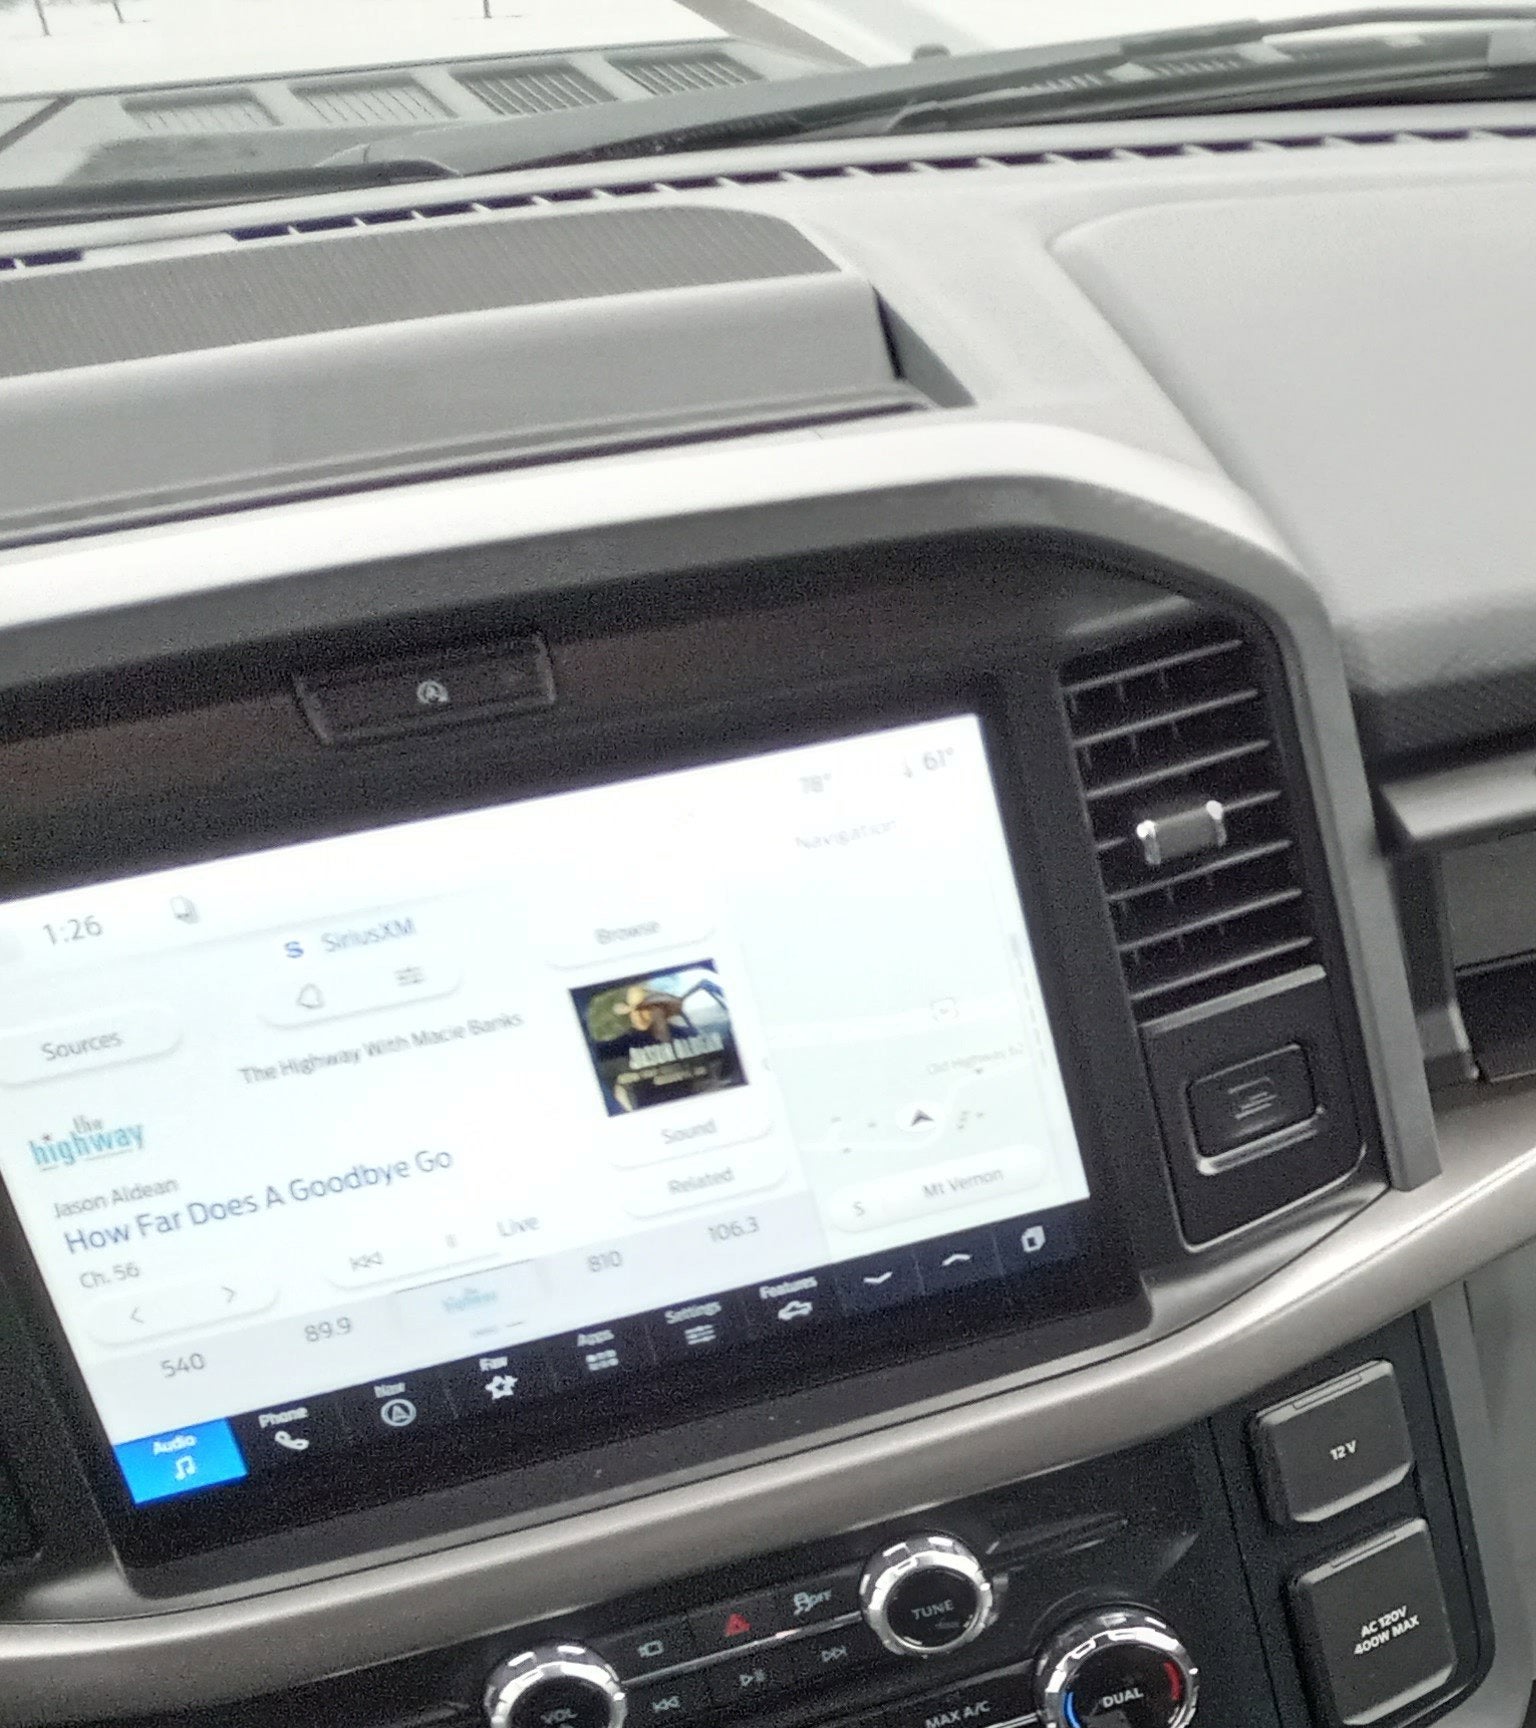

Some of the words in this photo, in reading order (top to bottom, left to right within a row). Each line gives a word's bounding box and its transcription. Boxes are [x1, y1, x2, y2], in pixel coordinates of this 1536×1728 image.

[42, 915, 104, 946] 1:26
[320, 917, 417, 952] SiriusXM
[40, 1030, 126, 1063] Sources
[238, 1063, 278, 1085] The
[279, 1048, 362, 1079] Highway
[363, 1036, 412, 1058] With
[412, 1024, 466, 1049] Macie
[466, 1011, 525, 1035] Banks
[72, 1114, 107, 1137] the
[659, 1117, 717, 1146] Sound
[27, 1123, 146, 1168] highway
[666, 1165, 736, 1197] Related
[922, 1182, 947, 1200] Mt
[948, 1166, 1006, 1194] Vernon
[53, 1195, 109, 1220] Jason
[110, 1177, 180, 1206] Aldean
[64, 1223, 133, 1256] How
[135, 1209, 183, 1237] Far
[187, 1193, 259, 1227] Does
[265, 1183, 288, 1208] A
[288, 1160, 412, 1206] Goodbye
[413, 1148, 454, 1174] Go
[497, 1214, 541, 1239] Live
[707, 1215, 761, 1246] 106.3
[79, 1266, 110, 1289] Ch.
[112, 1261, 141, 1283] 56
[758, 1275, 819, 1300] Features
[664, 1301, 723, 1325] Settings
[160, 1352, 207, 1379] 540
[303, 1316, 354, 1343] 89.9
[258, 1406, 309, 1429] Phone
[152, 1433, 198, 1456] Audio
[910, 1599, 955, 1620] TUNE
[1358, 1621, 1380, 1639] AC
[1378, 1604, 1409, 1632] 120V
[1353, 1628, 1391, 1657] 400W
[1386, 1614, 1421, 1643] MAX
[962, 1699, 991, 1724] A/C
[1101, 1685, 1145, 1709] DUAL
[540, 1706, 577, 1725] VOL
